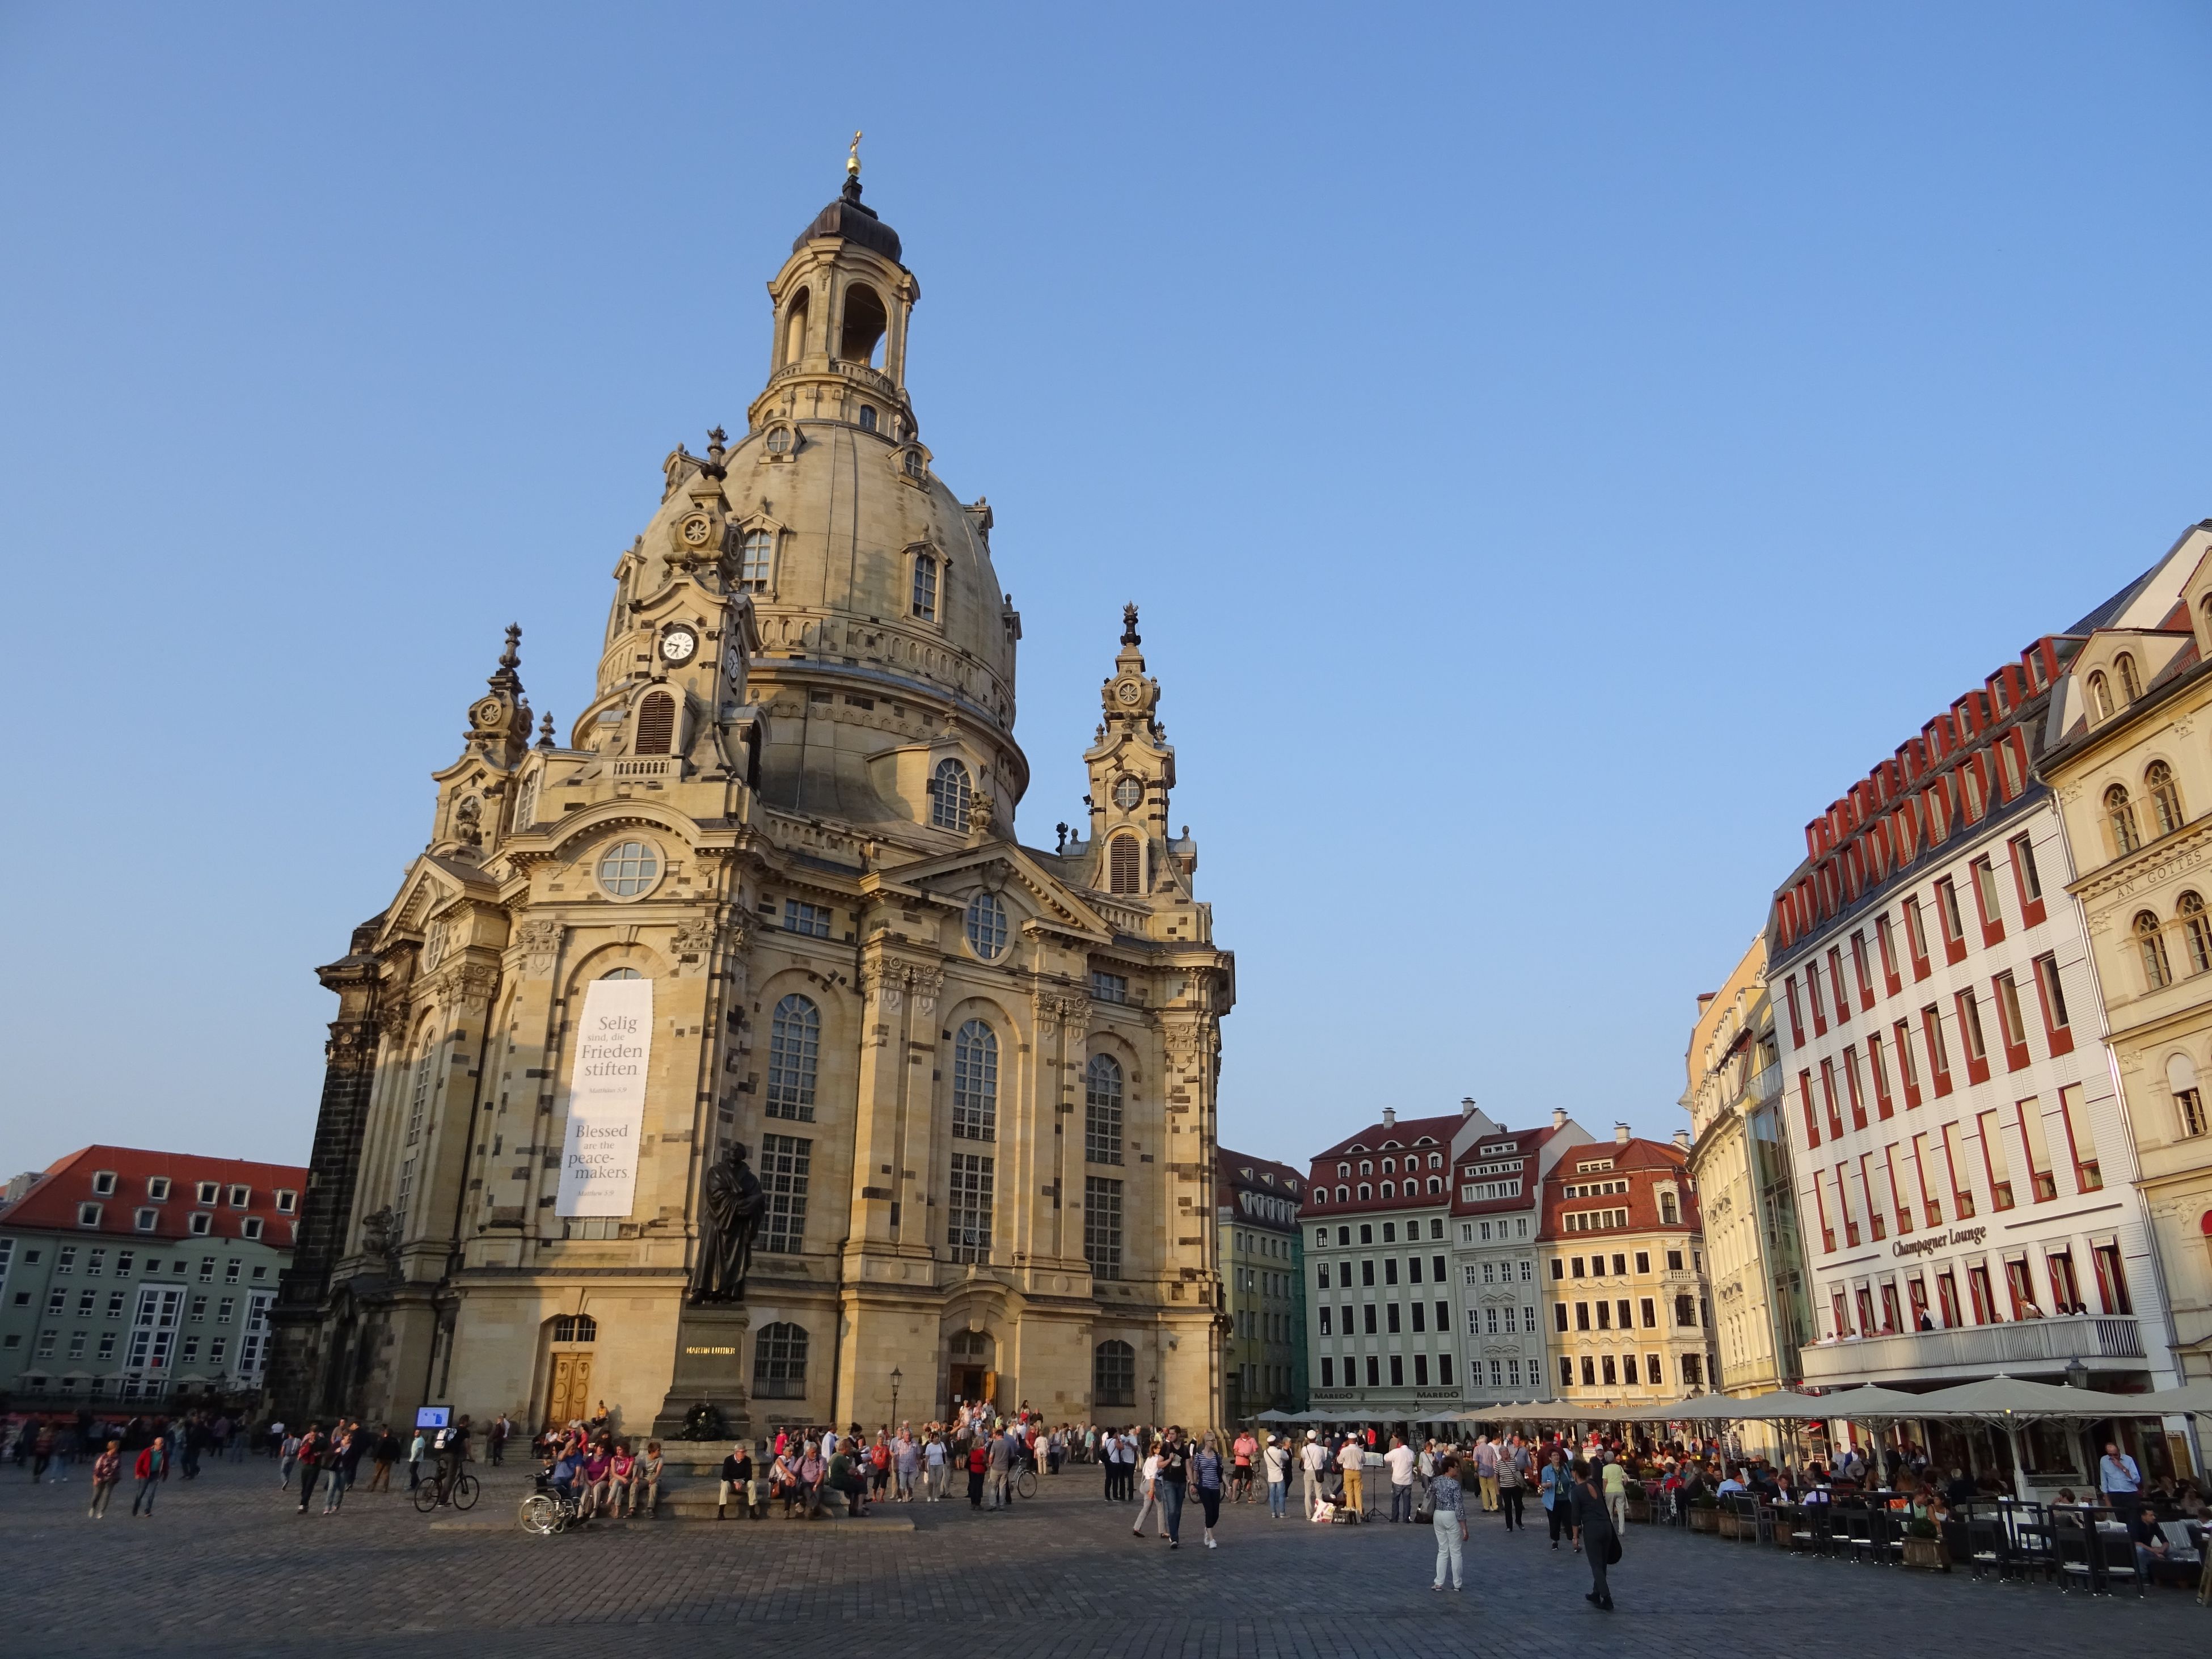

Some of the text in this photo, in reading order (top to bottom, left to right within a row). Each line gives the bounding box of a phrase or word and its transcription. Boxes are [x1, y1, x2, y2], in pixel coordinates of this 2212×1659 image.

[2117, 850, 2202, 899] AN GOTTES
[599, 1015, 639, 1033] Selig
[587, 1033, 608, 1042] sind,
[581, 1044, 643, 1058] Frieden
[576, 1124, 628, 1138] Blessed
[568, 1154, 614, 1168] peace-
[575, 1166, 630, 1179] makers.
[1892, 1225, 1986, 1257] Champagner Lounge
